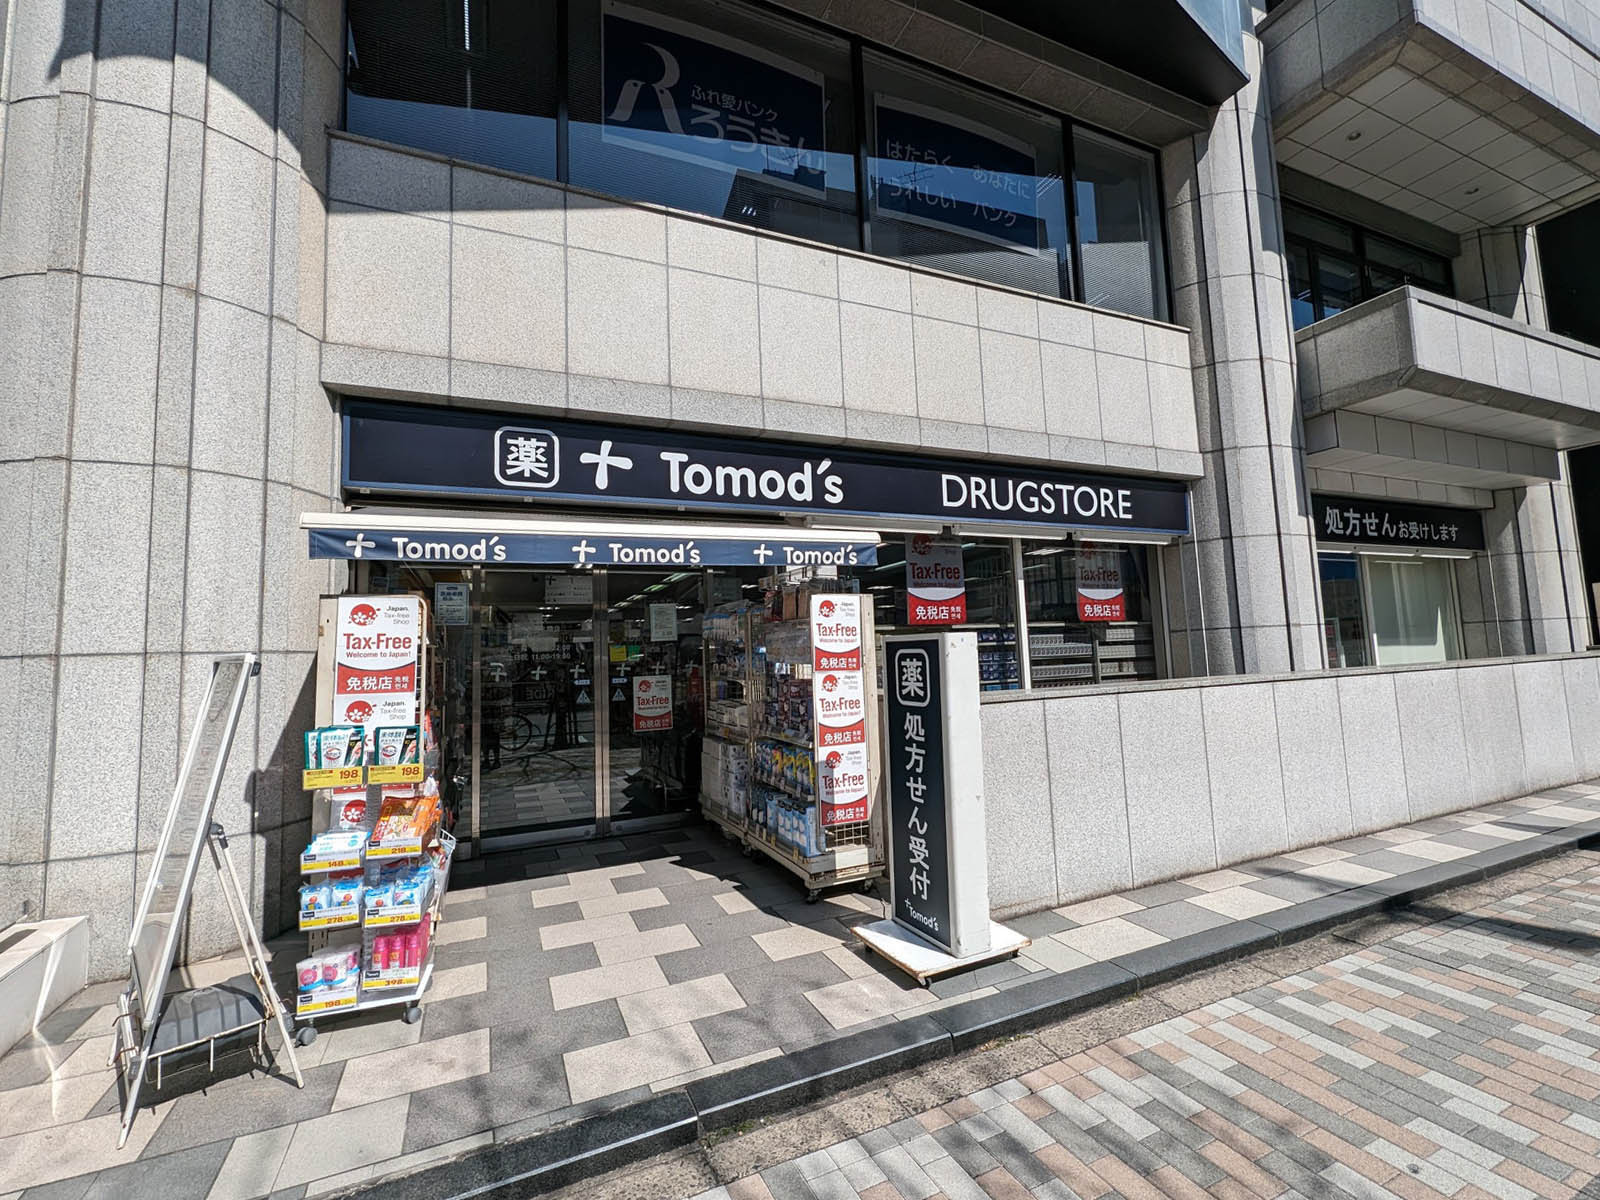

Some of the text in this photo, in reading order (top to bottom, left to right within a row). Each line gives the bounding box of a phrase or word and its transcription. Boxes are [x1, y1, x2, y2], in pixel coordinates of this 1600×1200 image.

[690, 84, 779, 123] ふれ愛バンク
[690, 104, 823, 173] ろうきん
[886, 139, 1032, 199] はたらく あなたに
[890, 176, 957, 209] うれしい
[506, 437, 549, 478] 薬
[660, 452, 1132, 519] Tomod's DRUGSTORE
[392, 536, 507, 561] Tomod's
[608, 541, 701, 564] Tomod's
[783, 545, 858, 565] Tomod's
[909, 562, 960, 580] Tax-Free
[915, 605, 949, 620] 免税店
[343, 633, 412, 649] Tax-Free
[816, 623, 857, 637] Tax-Free
[346, 676, 392, 691] 免税店
[901, 658, 924, 697] 薬
[636, 695, 669, 706] Tax-Free
[819, 697, 861, 713] Tax-Free
[822, 773, 865, 790] Tax-Free
[903, 712, 931, 900] 処方せん受付
[909, 906, 939, 931] Tomod's
